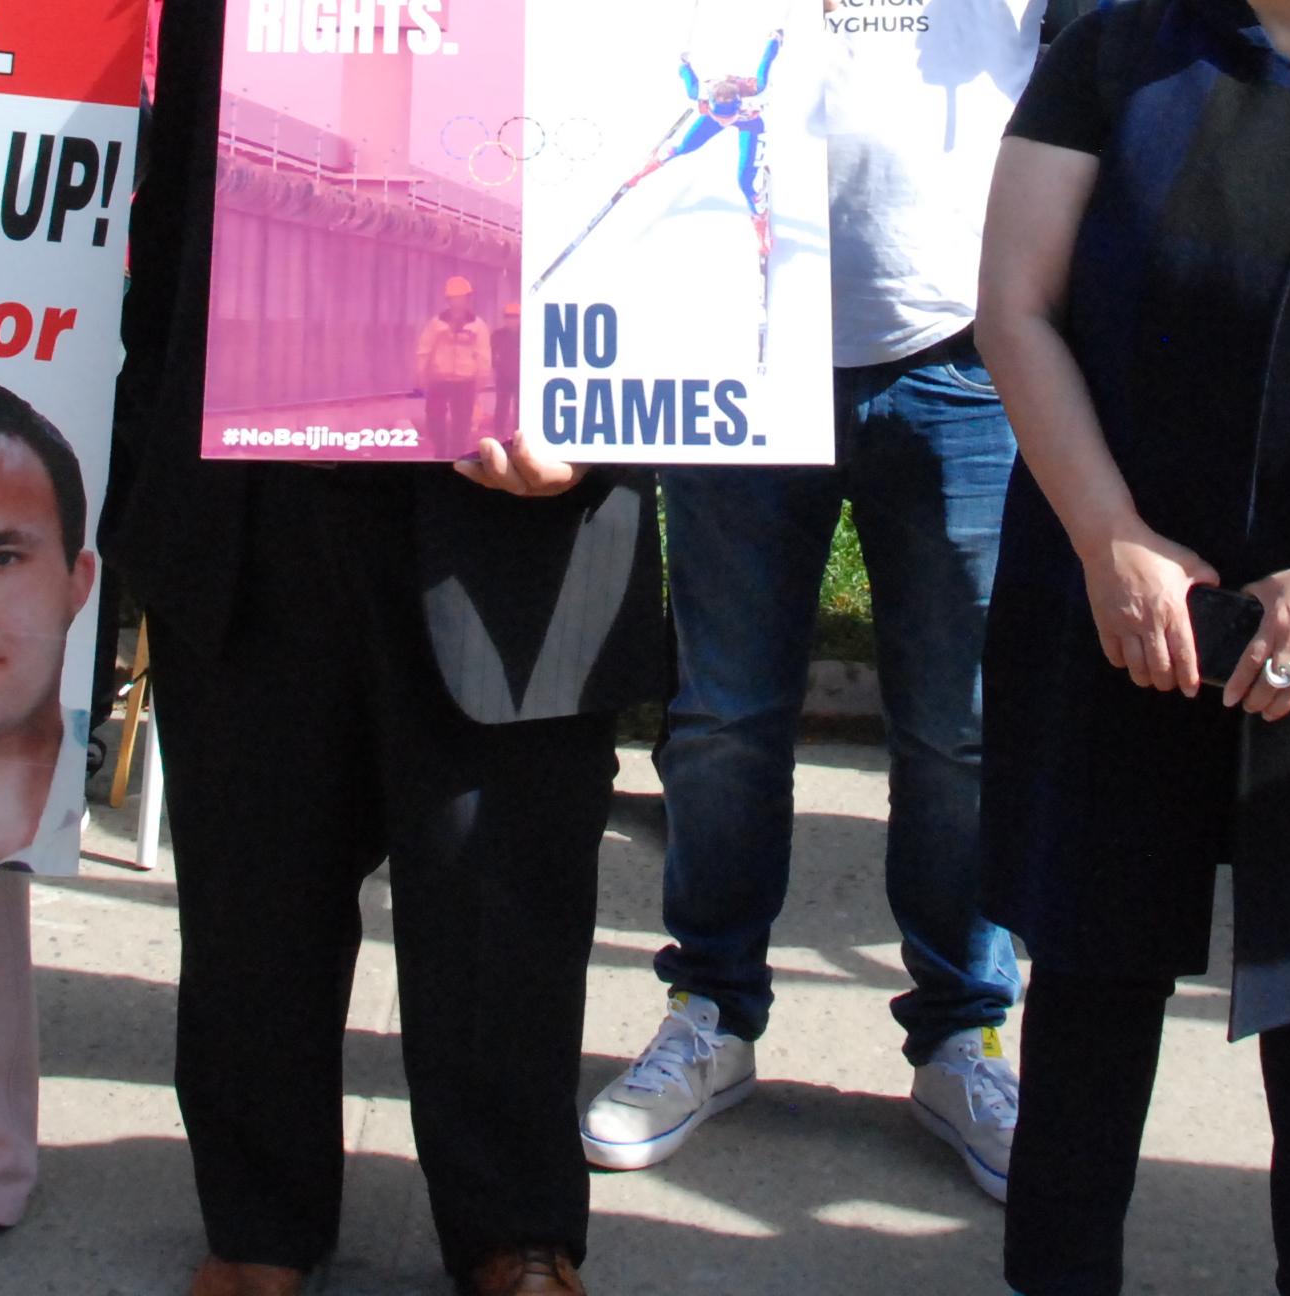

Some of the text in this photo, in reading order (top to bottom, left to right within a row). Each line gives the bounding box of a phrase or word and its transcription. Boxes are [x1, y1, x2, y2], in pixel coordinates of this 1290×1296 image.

[828, 15, 930, 34] YGHURS
[1, 132, 121, 248] UP!
[543, 303, 618, 368] NO
[222, 427, 418, 450] #NoBeijing2022
[543, 378, 766, 446] GAMES.
